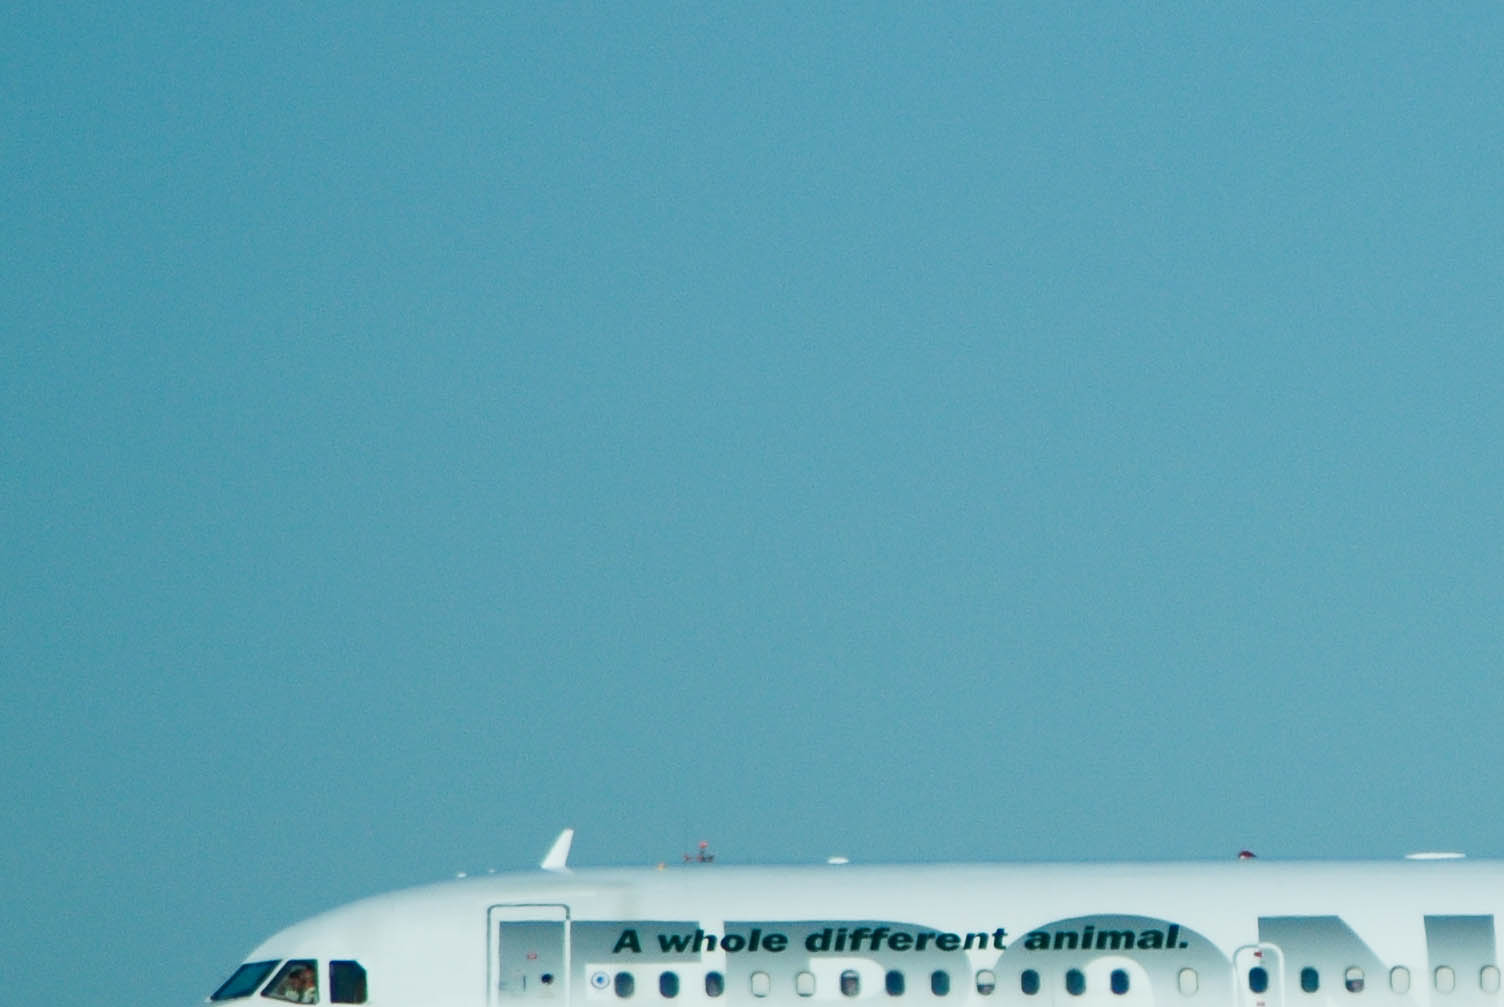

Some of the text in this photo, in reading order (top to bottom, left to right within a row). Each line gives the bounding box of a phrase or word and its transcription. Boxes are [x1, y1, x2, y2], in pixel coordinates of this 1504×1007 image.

[612, 923, 1189, 953] A whole different animal.
